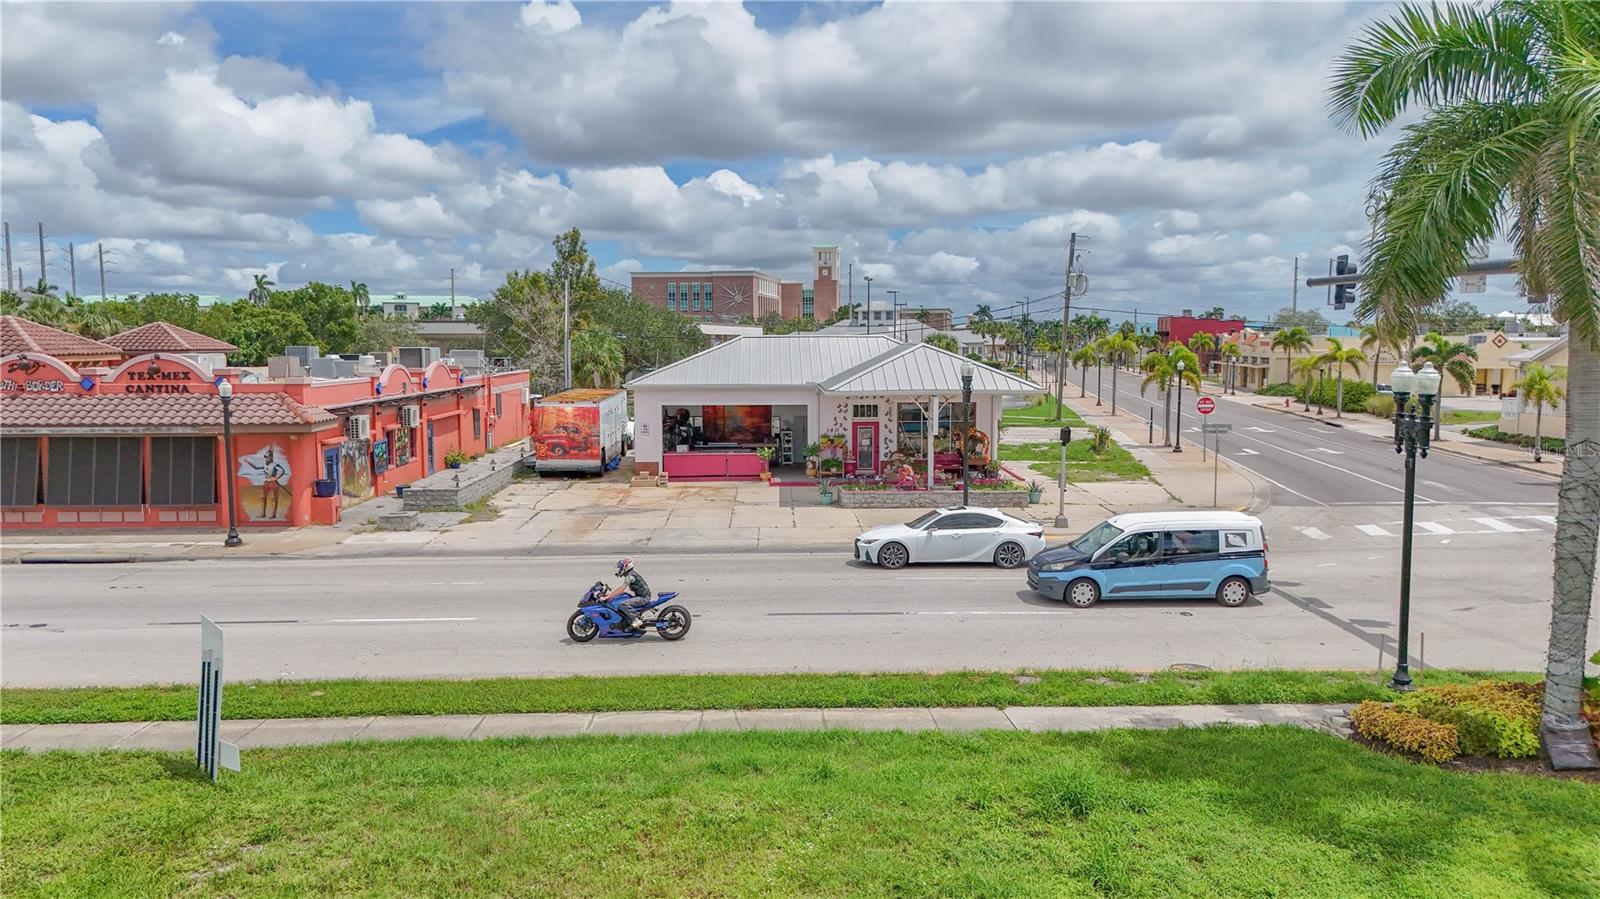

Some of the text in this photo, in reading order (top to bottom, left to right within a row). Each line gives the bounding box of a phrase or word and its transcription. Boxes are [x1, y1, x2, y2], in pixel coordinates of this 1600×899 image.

[127, 371, 191, 380] TEX-MEX
[25, 380, 64, 392] BORDER
[125, 384, 190, 394] CANTINA
